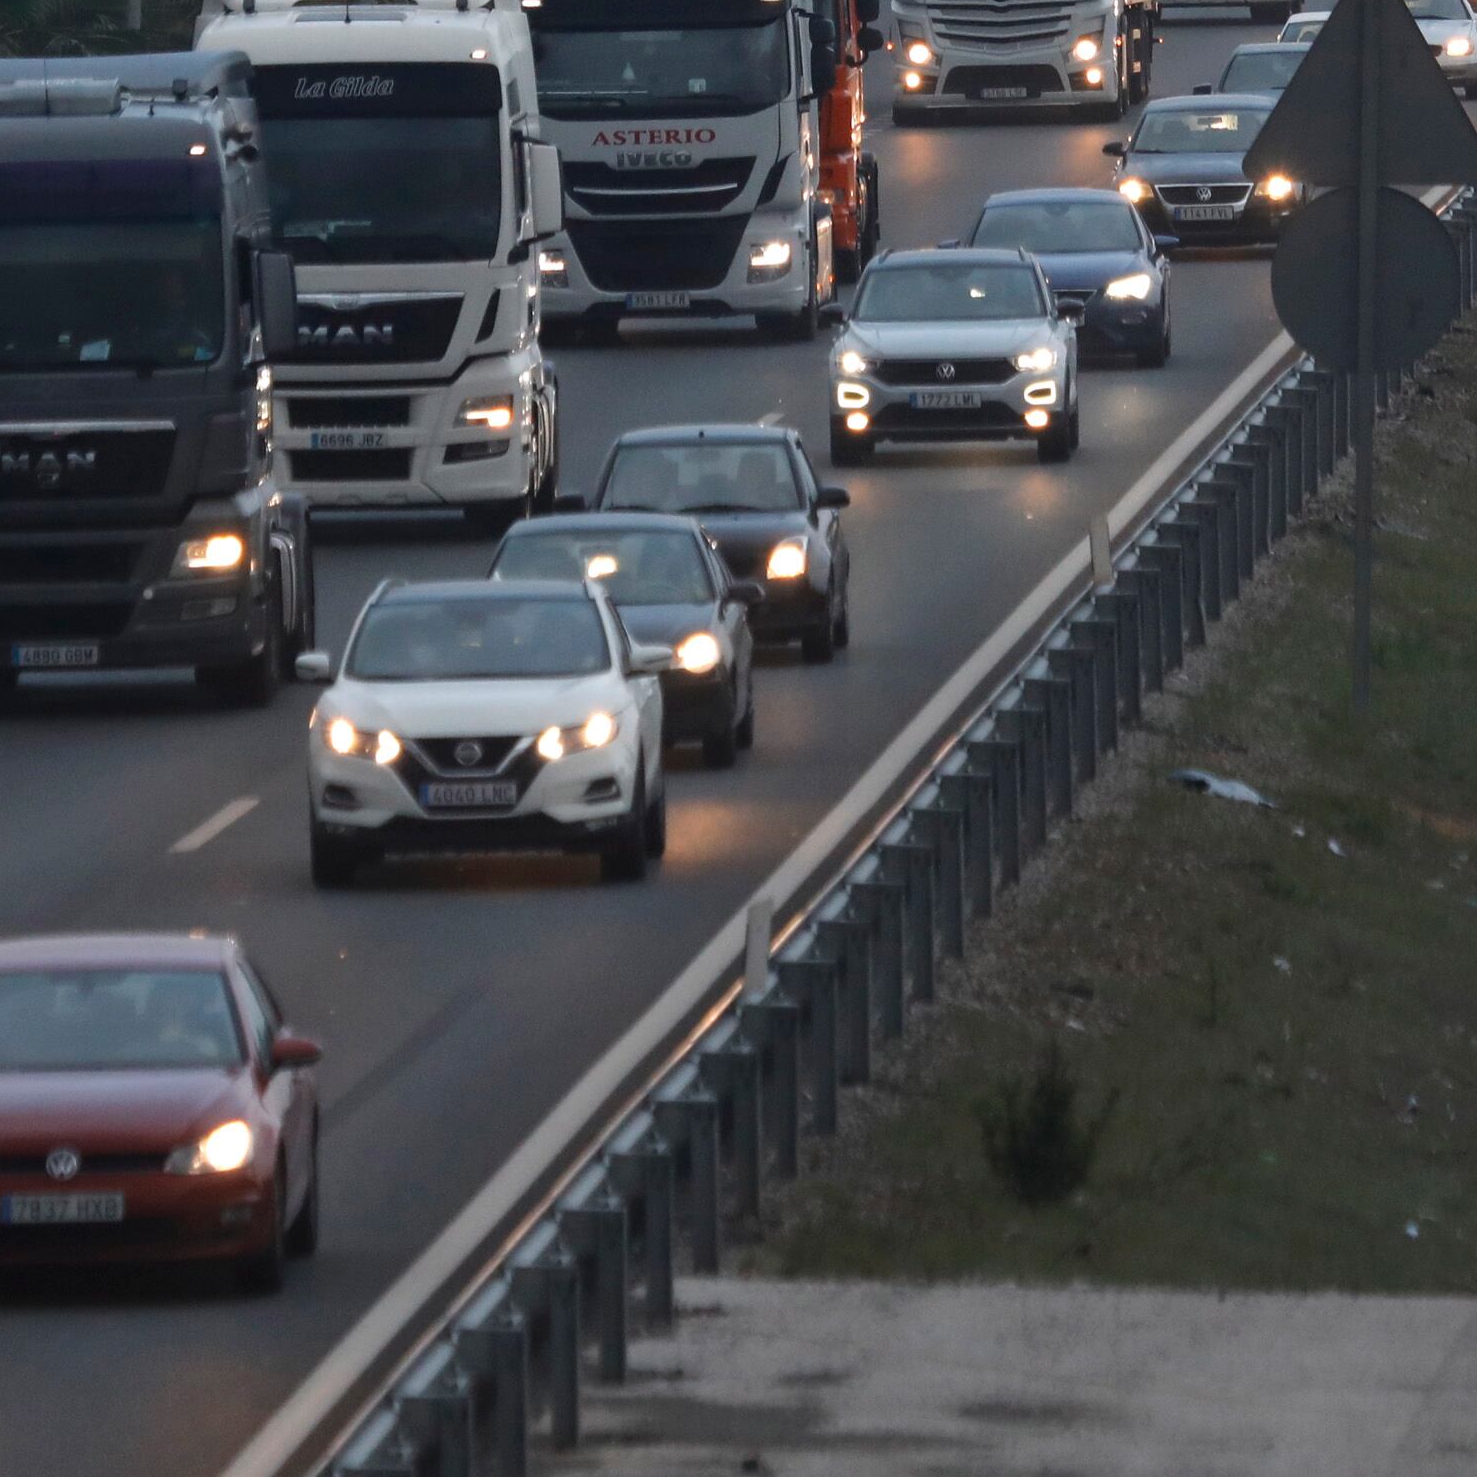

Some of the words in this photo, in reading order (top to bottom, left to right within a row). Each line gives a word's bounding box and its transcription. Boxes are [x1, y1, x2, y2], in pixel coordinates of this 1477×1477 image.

[294, 76, 326, 100] La
[328, 75, 395, 100] Gilda
[591, 128, 717, 147] ASTERIO
[616, 150, 693, 169] IVECO
[296, 322, 394, 346] MAN
[320, 434, 355, 447] 6696
[358, 433, 383, 446] JBZ
[0, 449, 96, 471] MAN
[433, 784, 475, 804] 4040
